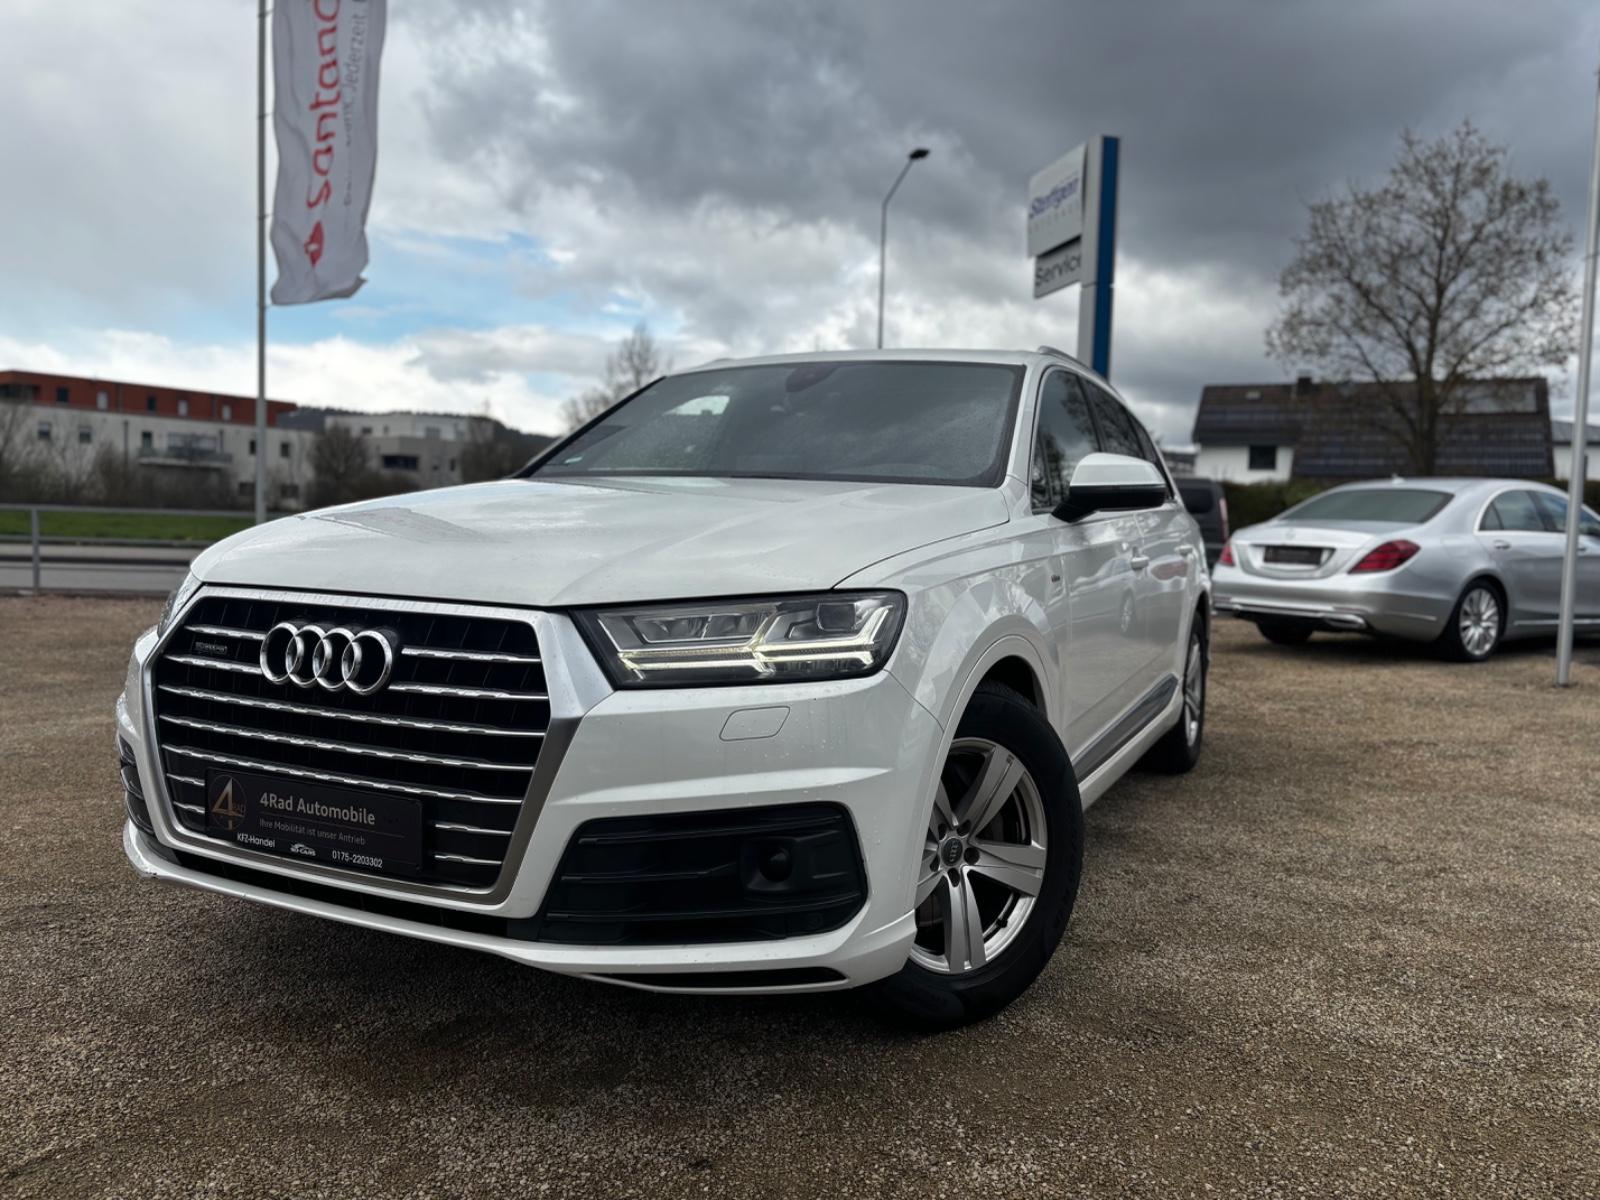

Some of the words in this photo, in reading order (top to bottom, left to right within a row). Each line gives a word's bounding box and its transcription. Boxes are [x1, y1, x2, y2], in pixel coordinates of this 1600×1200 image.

[259, 792, 294, 811] 4Rad
[296, 798, 376, 825] Automobile
[260, 818, 274, 829] Ihre
[338, 832, 366, 845] Antrieb
[332, 849, 383, 868] 0175-2203302
